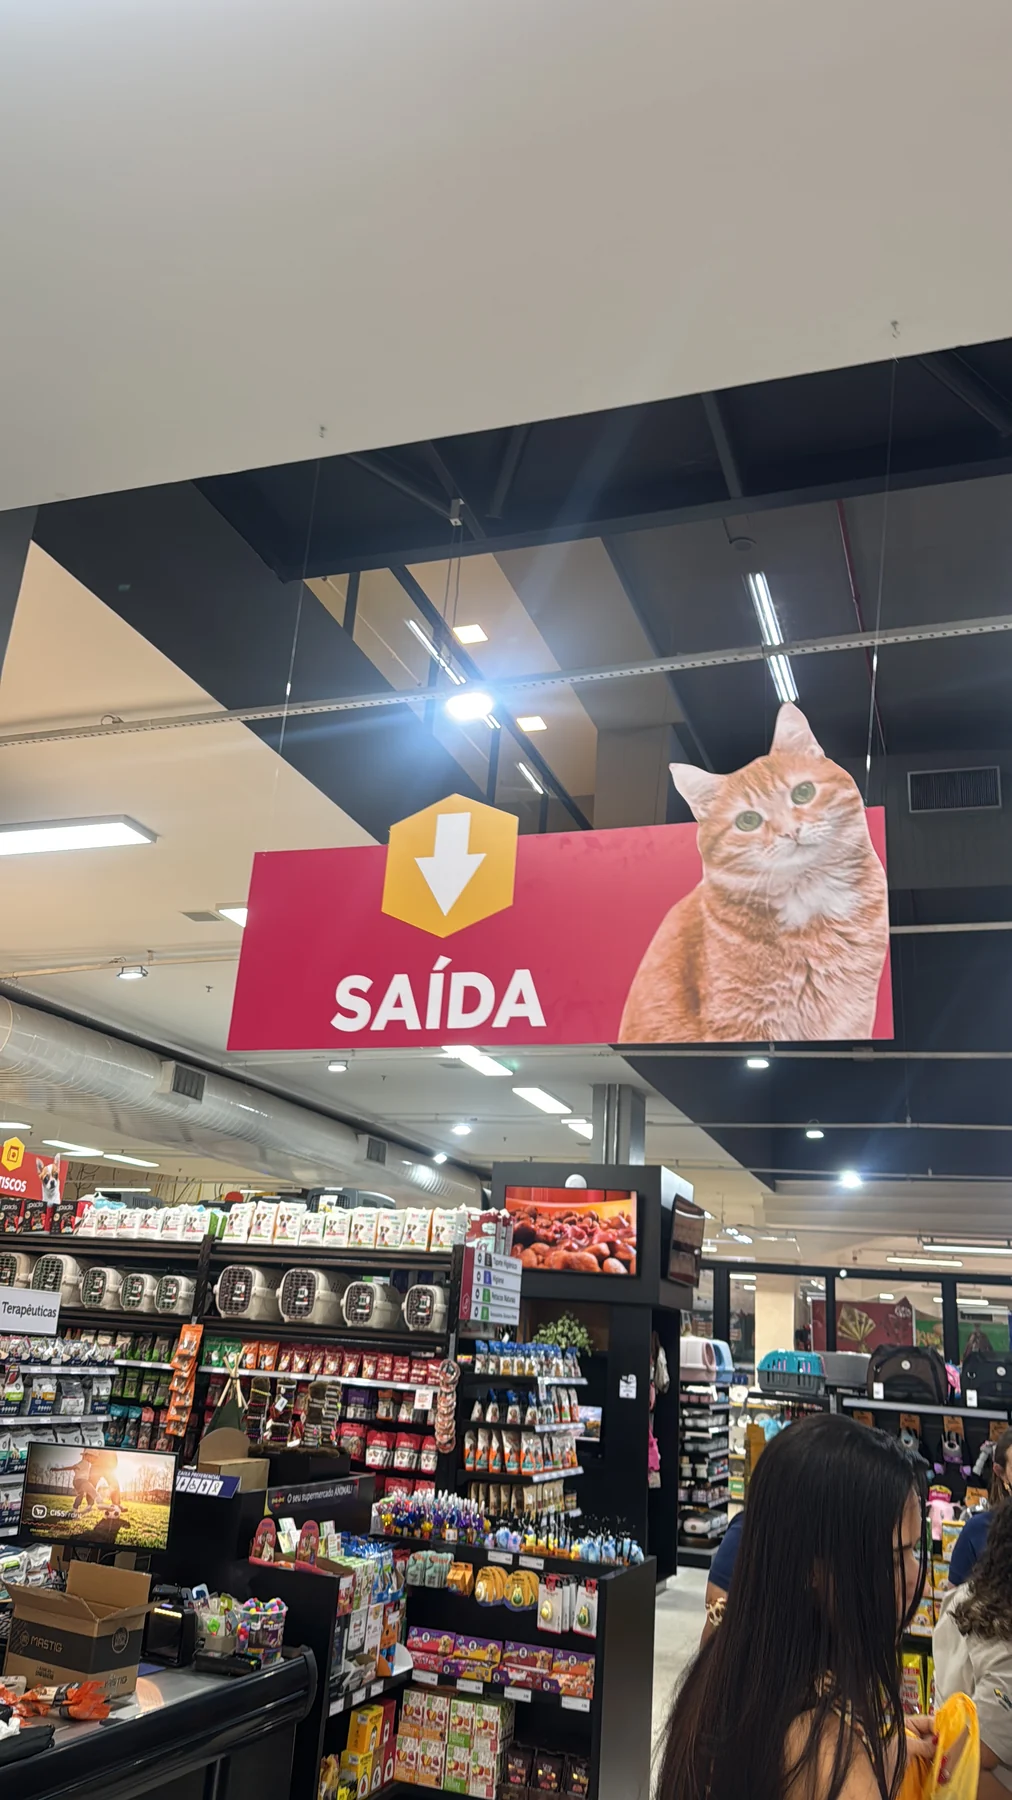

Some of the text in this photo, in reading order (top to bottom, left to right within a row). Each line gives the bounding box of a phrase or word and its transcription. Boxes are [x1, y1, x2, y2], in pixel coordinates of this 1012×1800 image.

[330, 955, 547, 1032] SAÍDA
[2, 1301, 57, 1318] Terapêuticas
[190, 1472, 220, 1481] PREFERENCIAL
[287, 1493, 292, 1504] O
[292, 1494, 302, 1504] seu
[301, 1489, 334, 1503] supermercado
[30, 1635, 63, 1653] MASTIG
